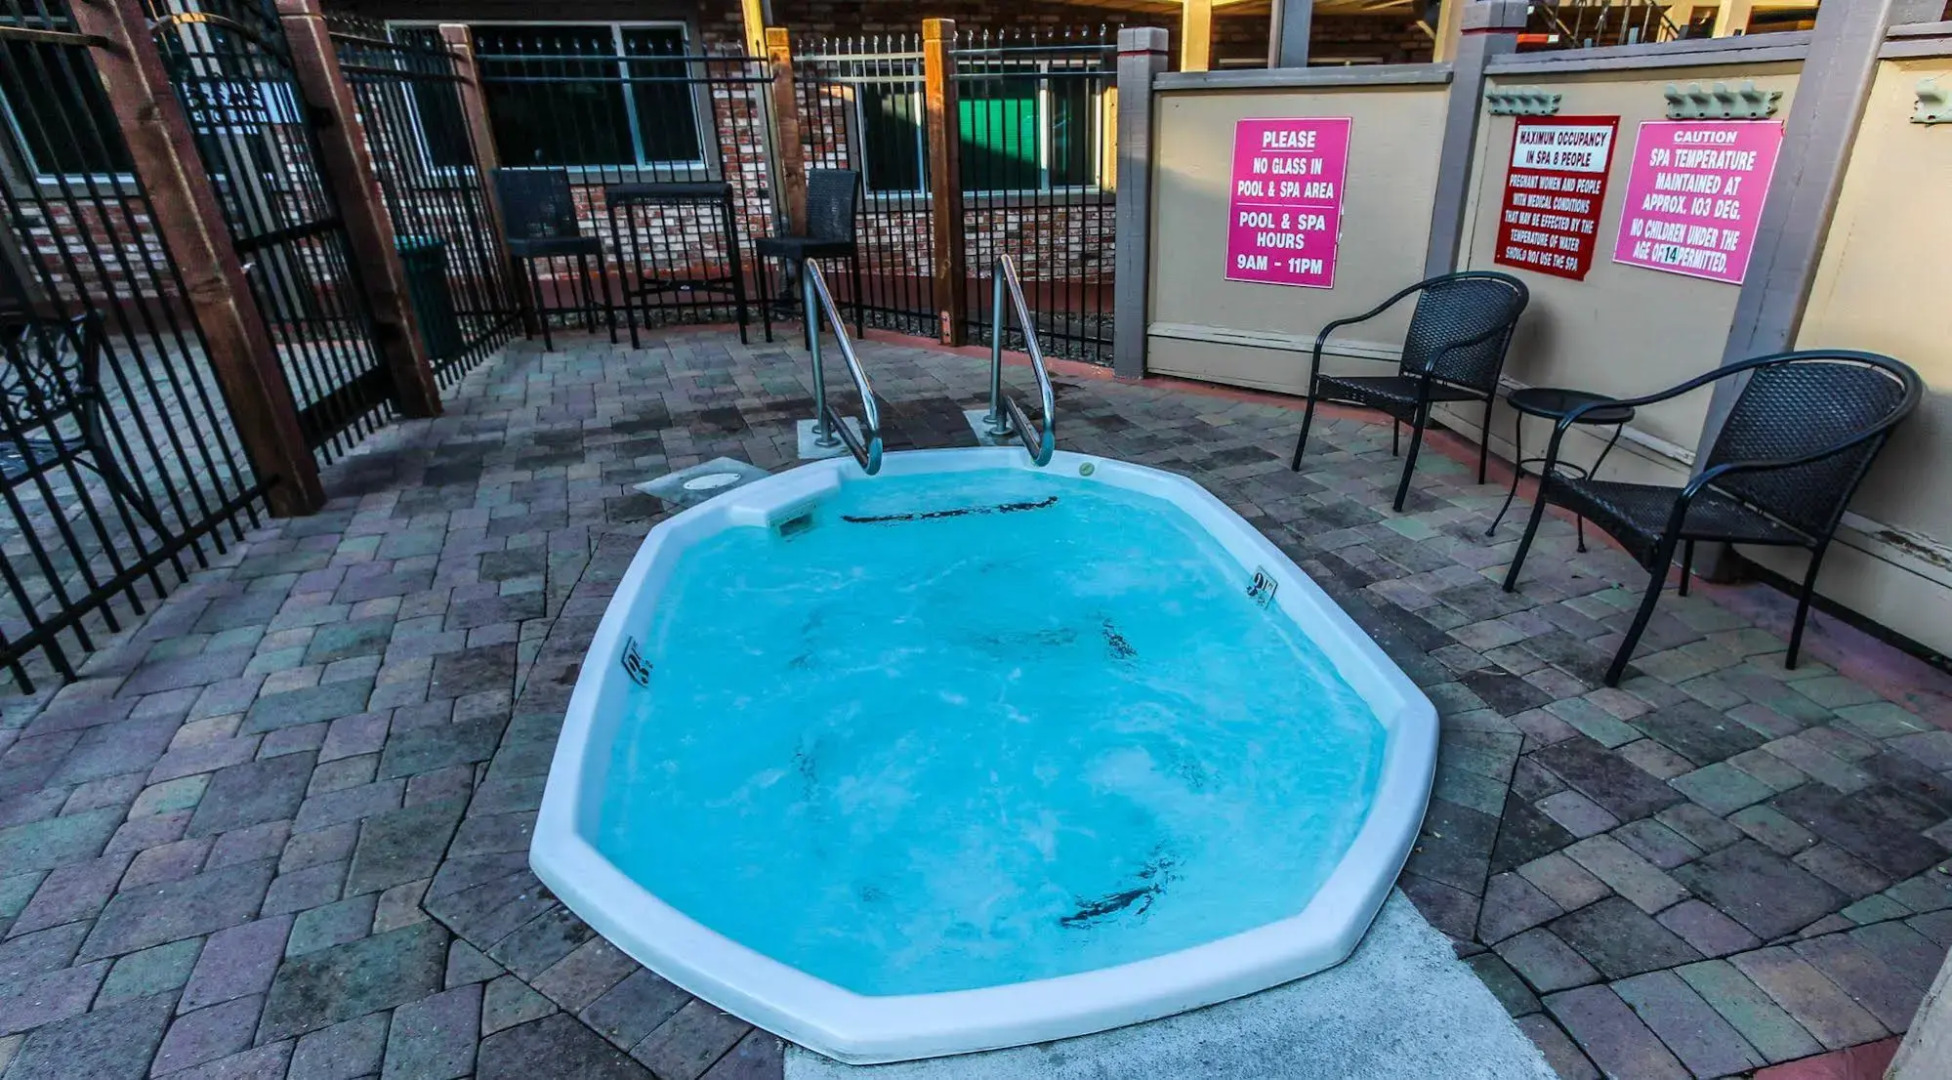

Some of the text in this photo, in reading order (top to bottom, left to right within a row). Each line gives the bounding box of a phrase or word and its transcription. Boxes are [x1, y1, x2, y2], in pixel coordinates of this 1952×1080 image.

[1262, 130, 1317, 148] PLEASE
[1519, 131, 1608, 148] MAXIMUM OCCUPANCY
[1673, 130, 1738, 143] CAUTION
[1253, 157, 1323, 175] NO GLASS IN
[1525, 150, 1535, 163] IN
[1536, 150, 1551, 164] SPA
[1561, 151, 1592, 167] PEOPLE
[1650, 148, 1757, 172] SPA TEMPERATURE
[1237, 180, 1334, 199] POOL & SPA AREA
[1509, 173, 1602, 195] PREGNANT WOMEN AND PEOPLE
[1655, 172, 1742, 196] MAINTAINED AT
[1527, 193, 1552, 210] MEDICAL
[1553, 196, 1591, 214] CONDITIONS
[1642, 193, 1741, 220] APPROX. 103 DEG.
[1239, 211, 1326, 231] POOL & SPA
[1505, 209, 1594, 234] THAT MAY BE EFFECTED BY THE
[1256, 232, 1305, 250] HOURS
[1510, 228, 1580, 252] TEMPERATURE OF WATER
[1630, 218, 1740, 251] NO CHILDREN UNDER THE
[1505, 246, 1578, 272] SHOULD NOT USE THE SPA
[1632, 240, 1651, 260] AGE
[1664, 246, 1677, 263] 14
[1237, 254, 1268, 271] 9AM
[1288, 257, 1323, 275] 11PM
